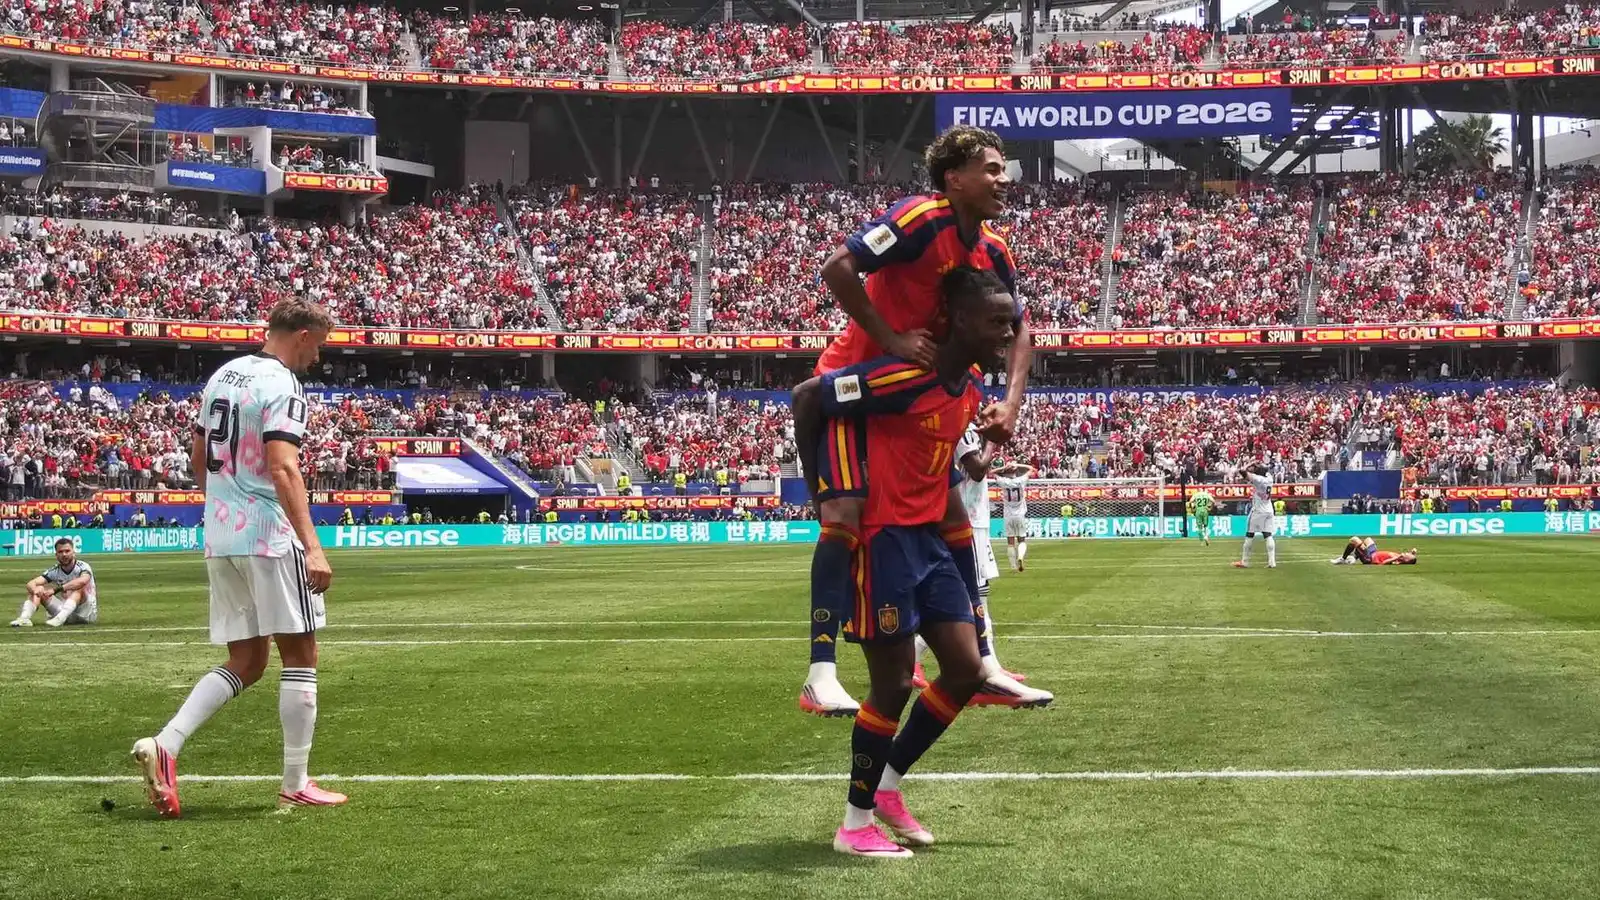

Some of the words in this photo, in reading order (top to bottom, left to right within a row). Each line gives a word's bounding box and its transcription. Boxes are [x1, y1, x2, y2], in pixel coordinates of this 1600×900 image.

[34, 41, 51, 52] SPAIN
[153, 52, 171, 63] SPAIN
[236, 60, 259, 70] GOAL!
[300, 65, 317, 75] SPAIN
[378, 72, 402, 82] GOAL!
[442, 74, 460, 84] SPAIN
[522, 78, 544, 88] GOAL!
[583, 80, 600, 91] SPAIN
[660, 83, 683, 92] GOAL!
[721, 83, 738, 92] SPAIN
[902, 76, 944, 90] GOAL!
[1020, 76, 1052, 90] SPAIN
[1170, 73, 1214, 88] GOAL!
[1289, 70, 1320, 84] SPAIN
[1440, 64, 1484, 79] GOAL!
[1562, 58, 1594, 73] SPAIN
[953, 106, 1010, 130] FIFA
[1014, 106, 1112, 128] WORLD
[1118, 105, 1172, 126] CUP
[1177, 102, 1272, 124] 2026
[172, 168, 214, 182] #FIFAWorldCup
[336, 178, 371, 190] GOAL!
[22, 318, 62, 333] GOAL!
[132, 322, 159, 336] SPAIN
[373, 332, 400, 346] SPAIN
[456, 333, 496, 348] GOAL!
[564, 335, 591, 348] SPAIN
[695, 336, 733, 350] GOAL!
[800, 336, 827, 349] SPAIN
[1035, 334, 1062, 347] SPAIN
[1164, 332, 1202, 346] GOAL!
[1268, 330, 1295, 344] SPAIN
[1399, 326, 1437, 340] GOAL!
[1504, 324, 1531, 338] SPAIN
[206, 398, 240, 477] 21
[415, 441, 442, 454] SPAIN
[136, 493, 154, 504] SPAIN
[557, 498, 578, 508] SPAIN
[658, 498, 686, 508] GOAL!
[738, 497, 758, 508] SPAIN
[1040, 488, 1068, 499] GOAL!
[1118, 488, 1138, 498] SPAIN
[1216, 486, 1245, 496] GOAL!
[1294, 486, 1315, 496] SPAIN
[1197, 498, 1208, 507] 23
[1519, 488, 1548, 498] GOAL!
[89, 502, 110, 514] GOAL!
[502, 522, 542, 544] 海信
[546, 524, 586, 542] RGB
[591, 521, 667, 541] MiniLED
[669, 521, 710, 542] 电视
[726, 520, 810, 542] 世界第一
[1024, 518, 1064, 538] 海信
[1068, 519, 1108, 536] RGB
[1381, 516, 1504, 536] Hisense
[1544, 512, 1586, 532] 海信
[14, 530, 82, 555] Hisene
[102, 528, 122, 550] 海信
[123, 529, 143, 548] RGB
[144, 528, 180, 548] MiniLED
[336, 525, 460, 547] Hisense
